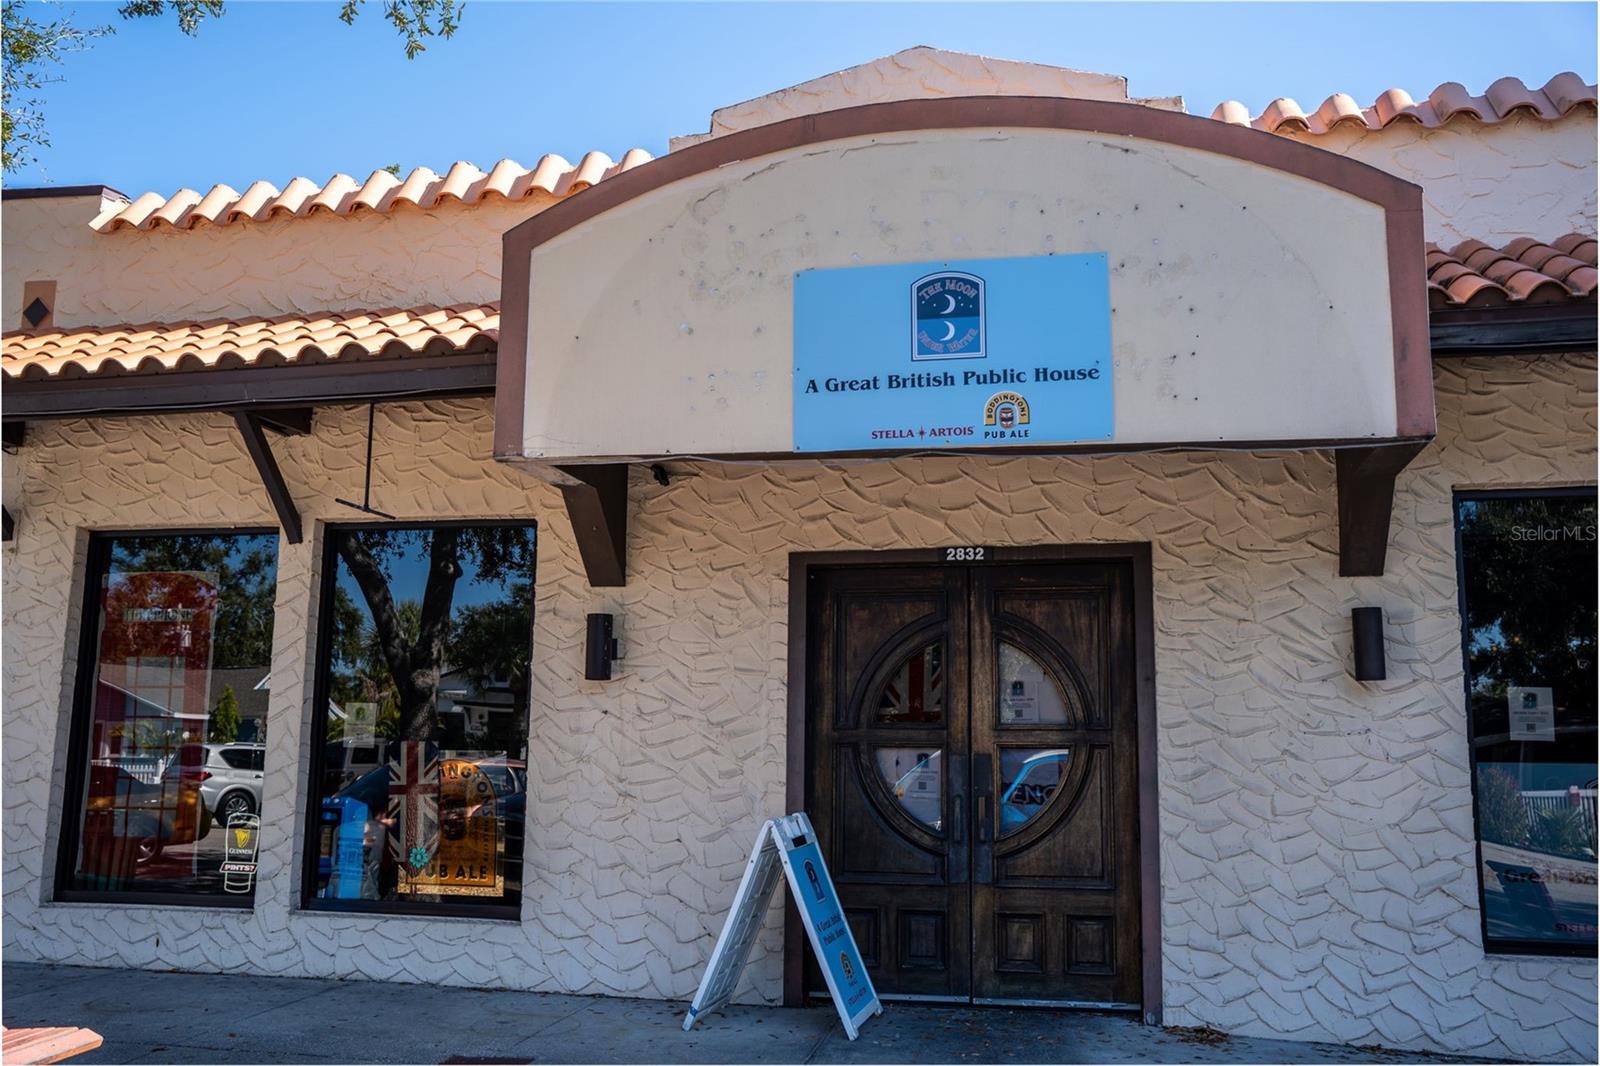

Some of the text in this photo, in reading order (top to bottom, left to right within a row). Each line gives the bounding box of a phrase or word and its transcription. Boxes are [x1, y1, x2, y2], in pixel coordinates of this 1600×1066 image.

[945, 279, 978, 299] MOON
[805, 367, 1100, 393] A Great British Public House
[986, 394, 1026, 418] BODDINGTONS
[871, 426, 974, 439] STELLA ARTOIS
[984, 429, 1030, 439] PUB ALE
[946, 547, 985, 560] 2832
[224, 864, 255, 872] PINTS?
[455, 863, 489, 881] ALE
